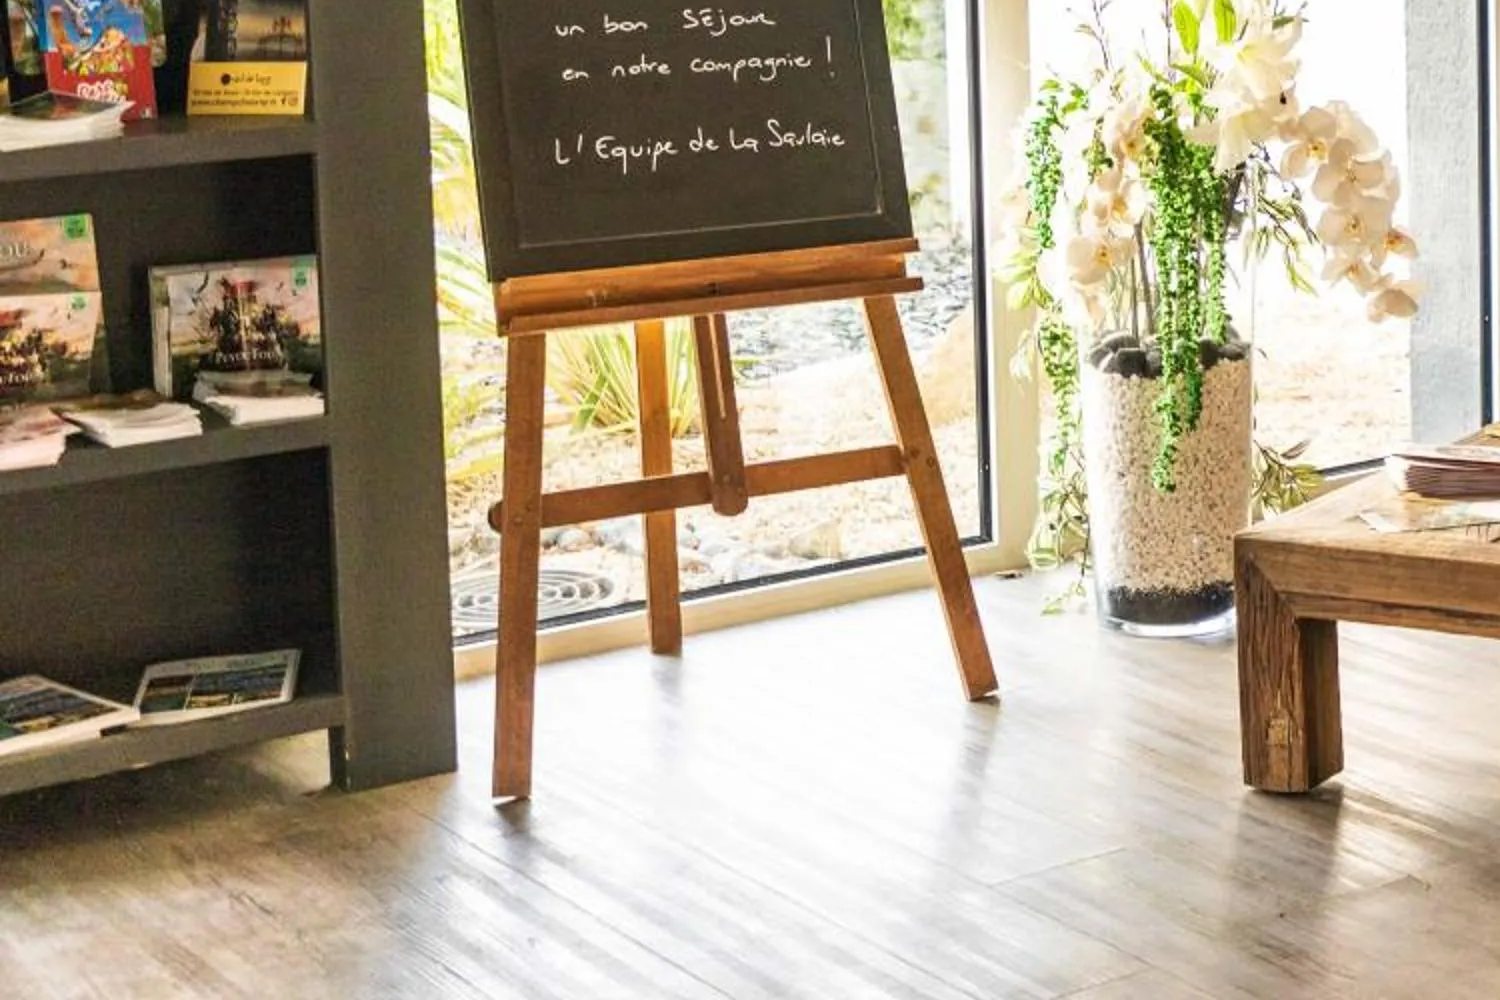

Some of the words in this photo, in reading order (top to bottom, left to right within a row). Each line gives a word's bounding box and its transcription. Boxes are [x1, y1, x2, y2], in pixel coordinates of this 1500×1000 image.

[554, 24, 586, 37] un
[603, 13, 649, 35] bon
[561, 68, 590, 81] en
[611, 52, 672, 78] notre
[689, 52, 812, 83] compagnie
[688, 126, 720, 153] de
[729, 127, 759, 153] La
[766, 118, 846, 148] Saulaie
